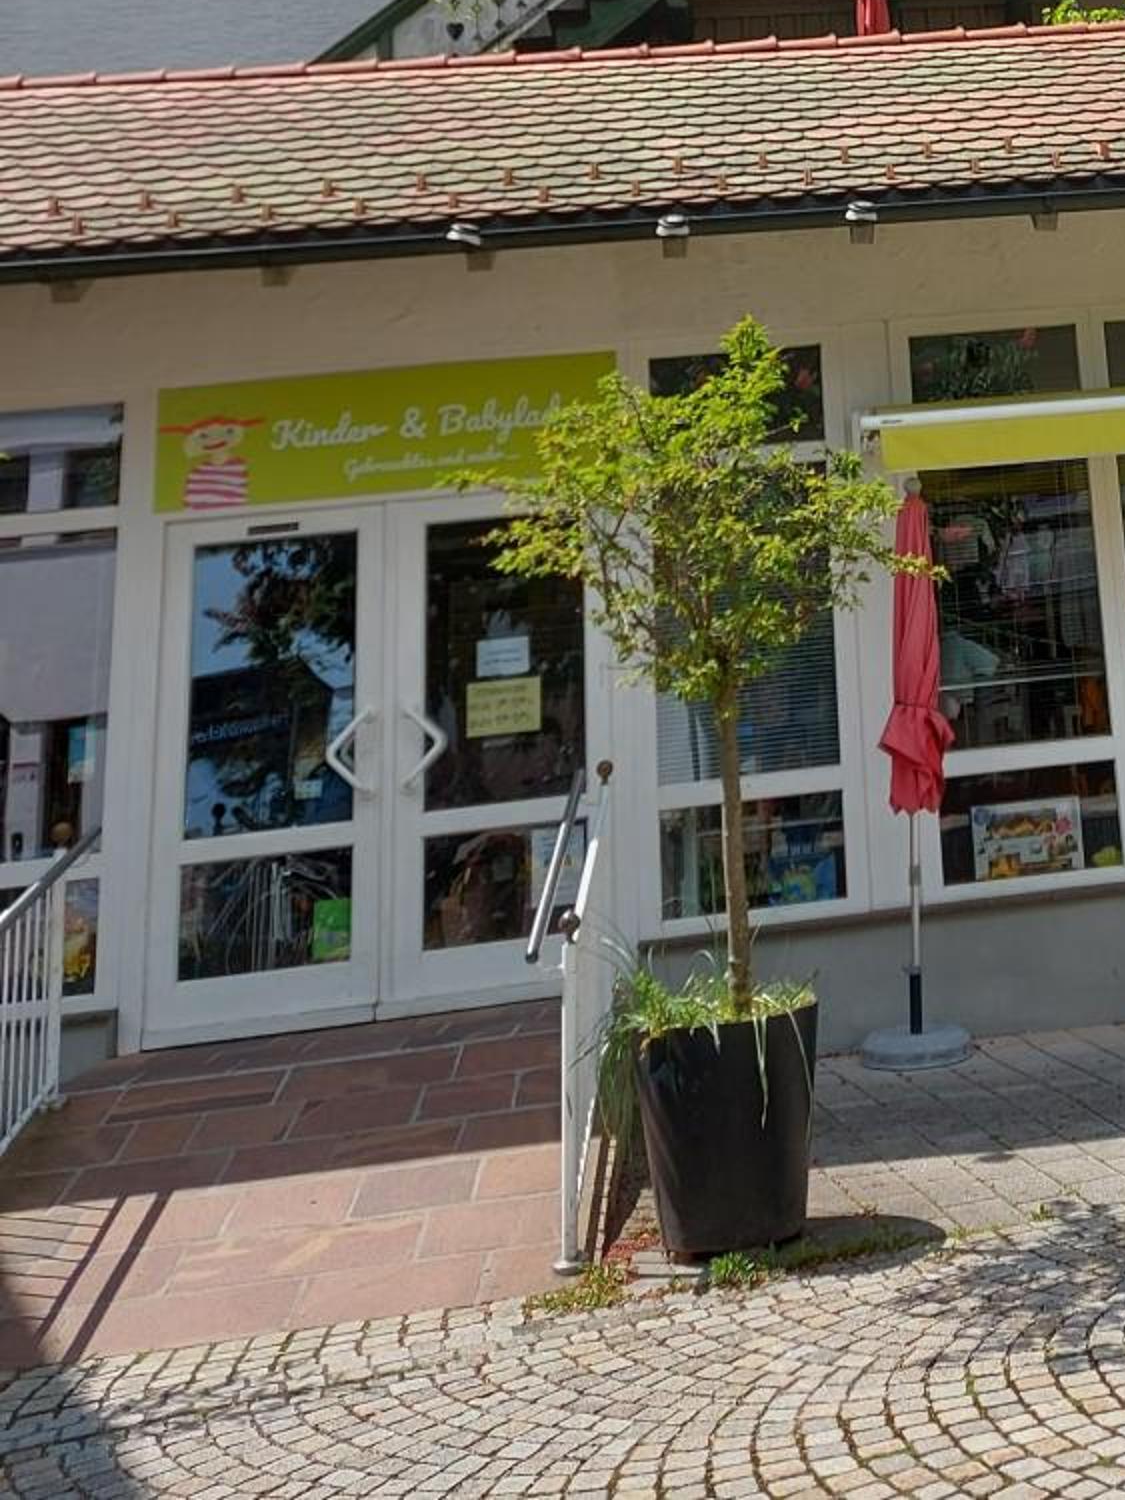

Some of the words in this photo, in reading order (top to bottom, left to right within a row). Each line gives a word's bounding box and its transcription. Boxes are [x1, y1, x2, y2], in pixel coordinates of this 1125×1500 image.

[271, 410, 388, 451] Kinder
[399, 406, 427, 439] &
[437, 392, 566, 446] Babylad
